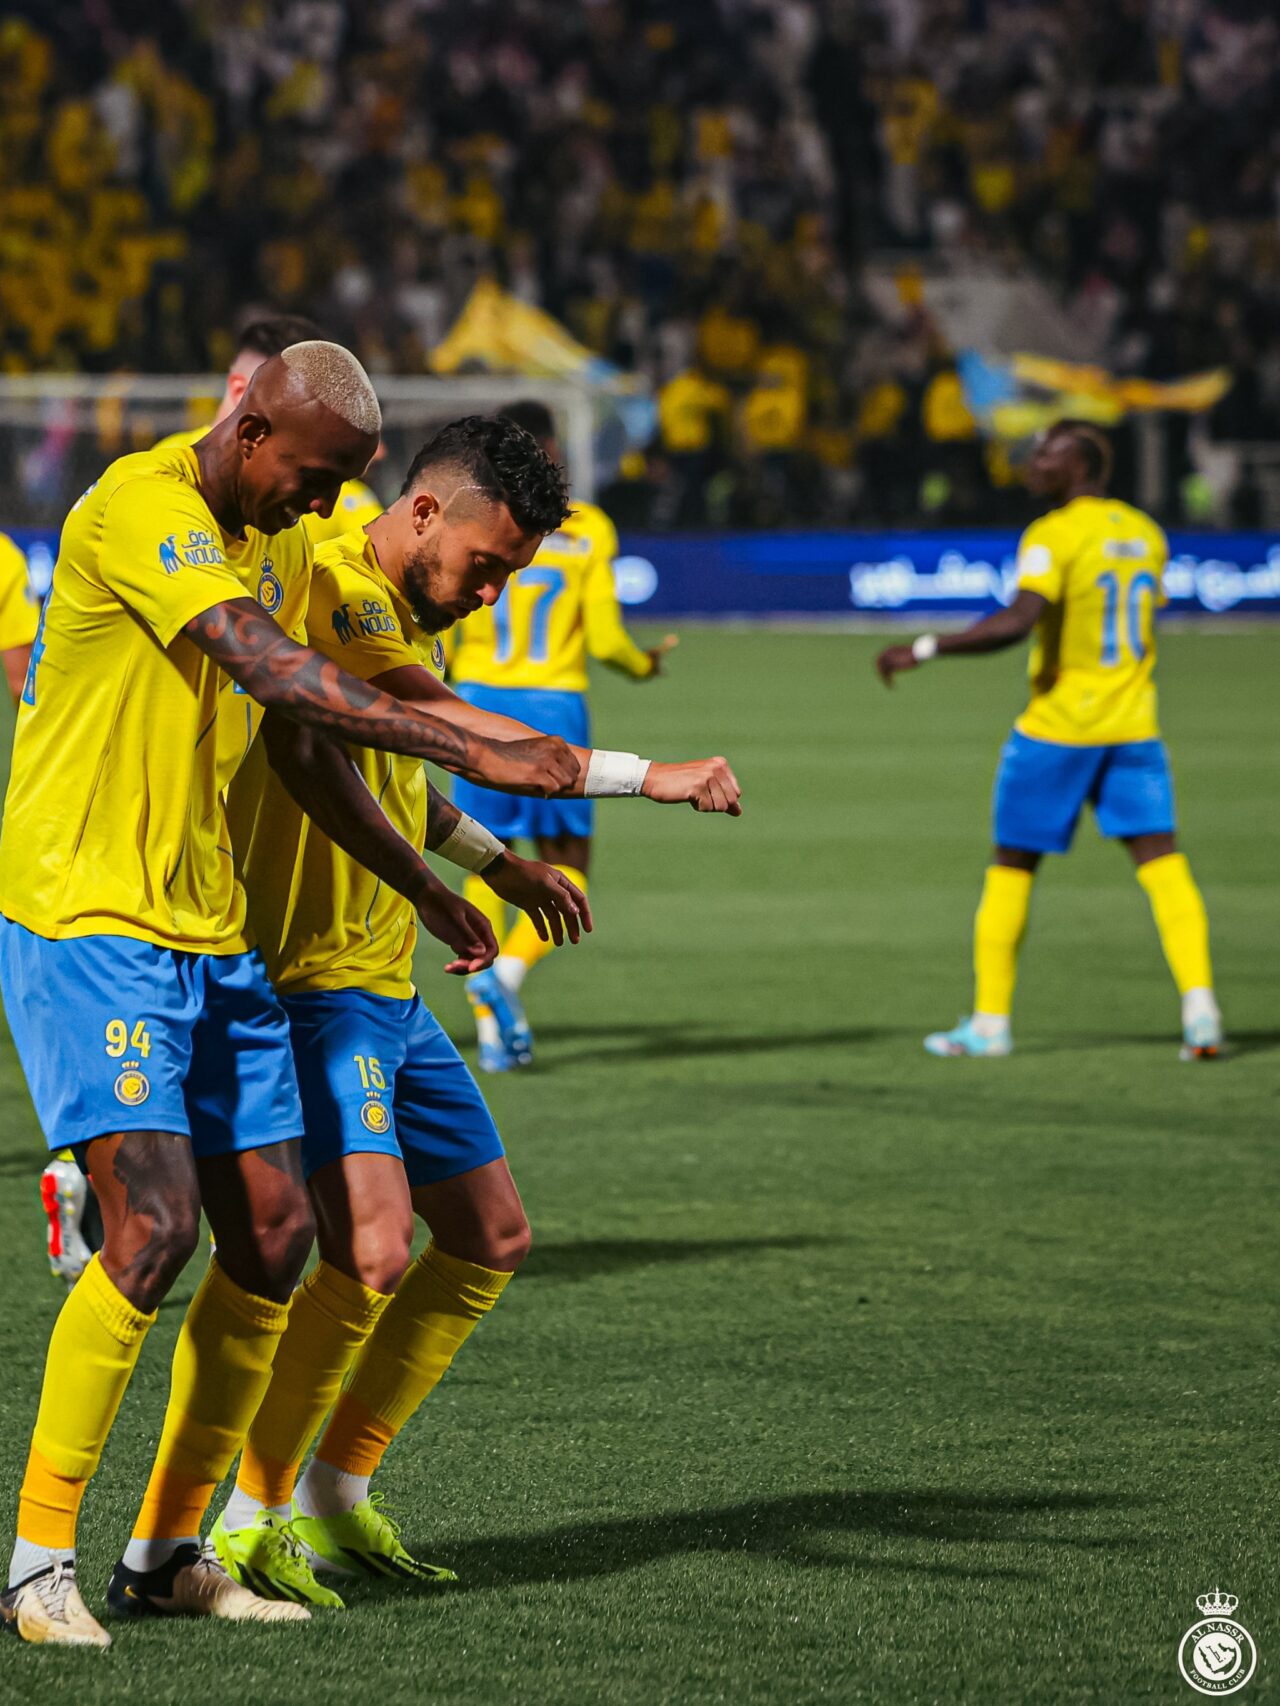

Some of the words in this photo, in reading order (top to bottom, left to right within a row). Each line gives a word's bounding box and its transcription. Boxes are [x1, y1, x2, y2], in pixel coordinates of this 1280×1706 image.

[184, 547, 222, 565] NOUG
[359, 616, 396, 635] NOUG
[1097, 571, 1157, 666] 10
[105, 1018, 153, 1058] 94
[353, 1055, 387, 1090] 15
